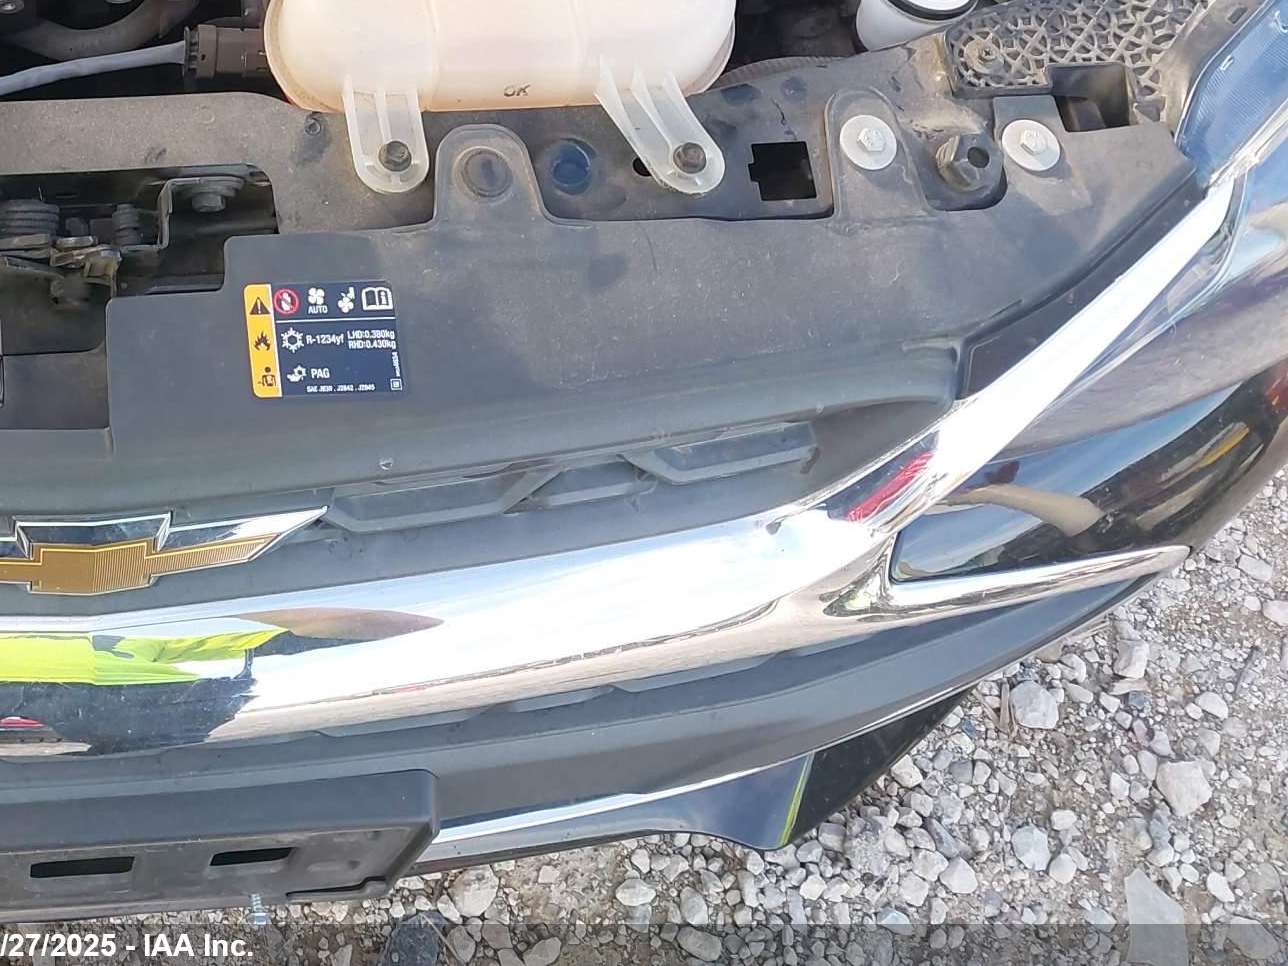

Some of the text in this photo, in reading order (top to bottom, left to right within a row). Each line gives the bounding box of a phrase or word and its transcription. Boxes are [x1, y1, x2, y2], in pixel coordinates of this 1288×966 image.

[308, 306, 328, 314] AUTO
[306, 334, 344, 346] R-1234yf
[311, 368, 330, 379] PAG
